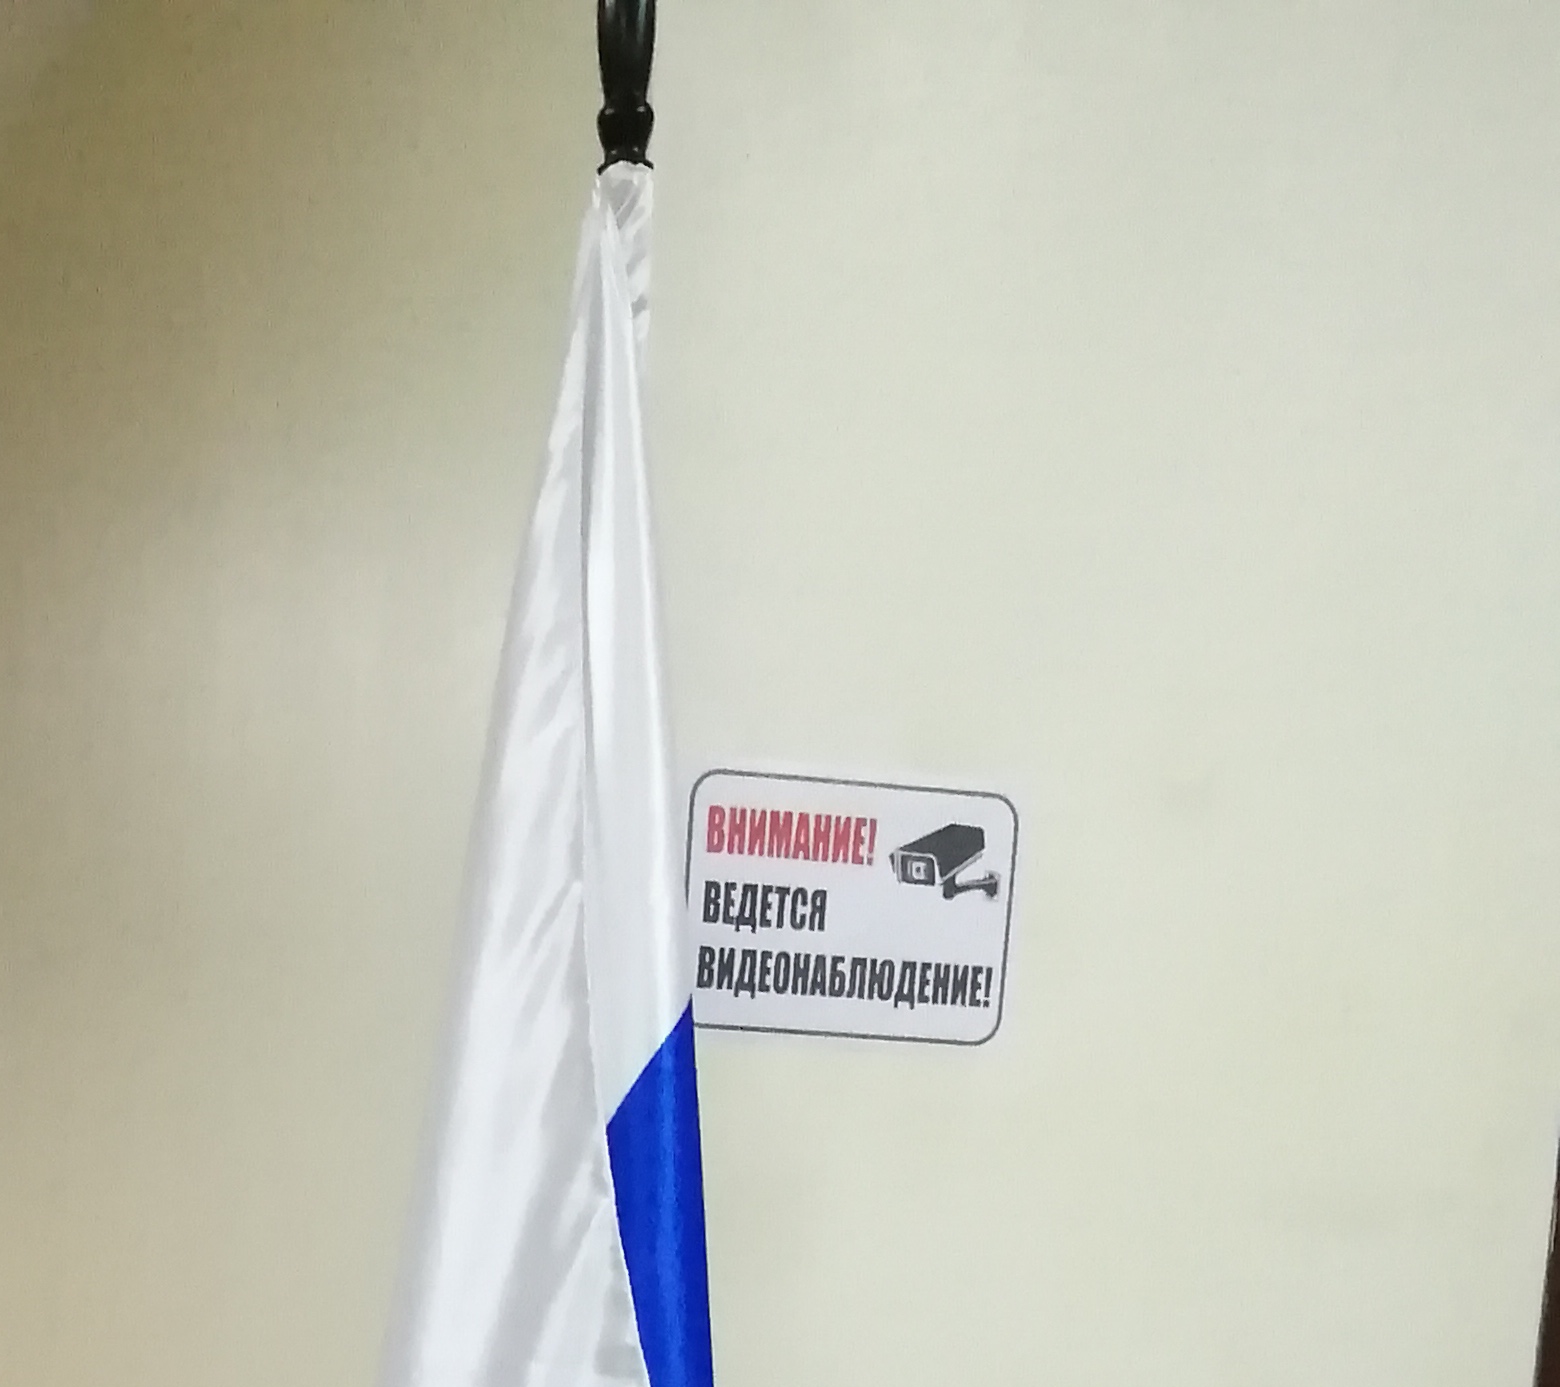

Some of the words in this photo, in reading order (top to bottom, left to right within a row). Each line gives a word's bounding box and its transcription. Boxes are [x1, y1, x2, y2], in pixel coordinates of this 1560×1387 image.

[706, 804, 878, 867] ВНИМАНИЕ!
[702, 880, 828, 934] ВЕДЕТСЯ
[696, 945, 994, 1010] ВИДЕОНАБЛЮДЕНИЕ!
